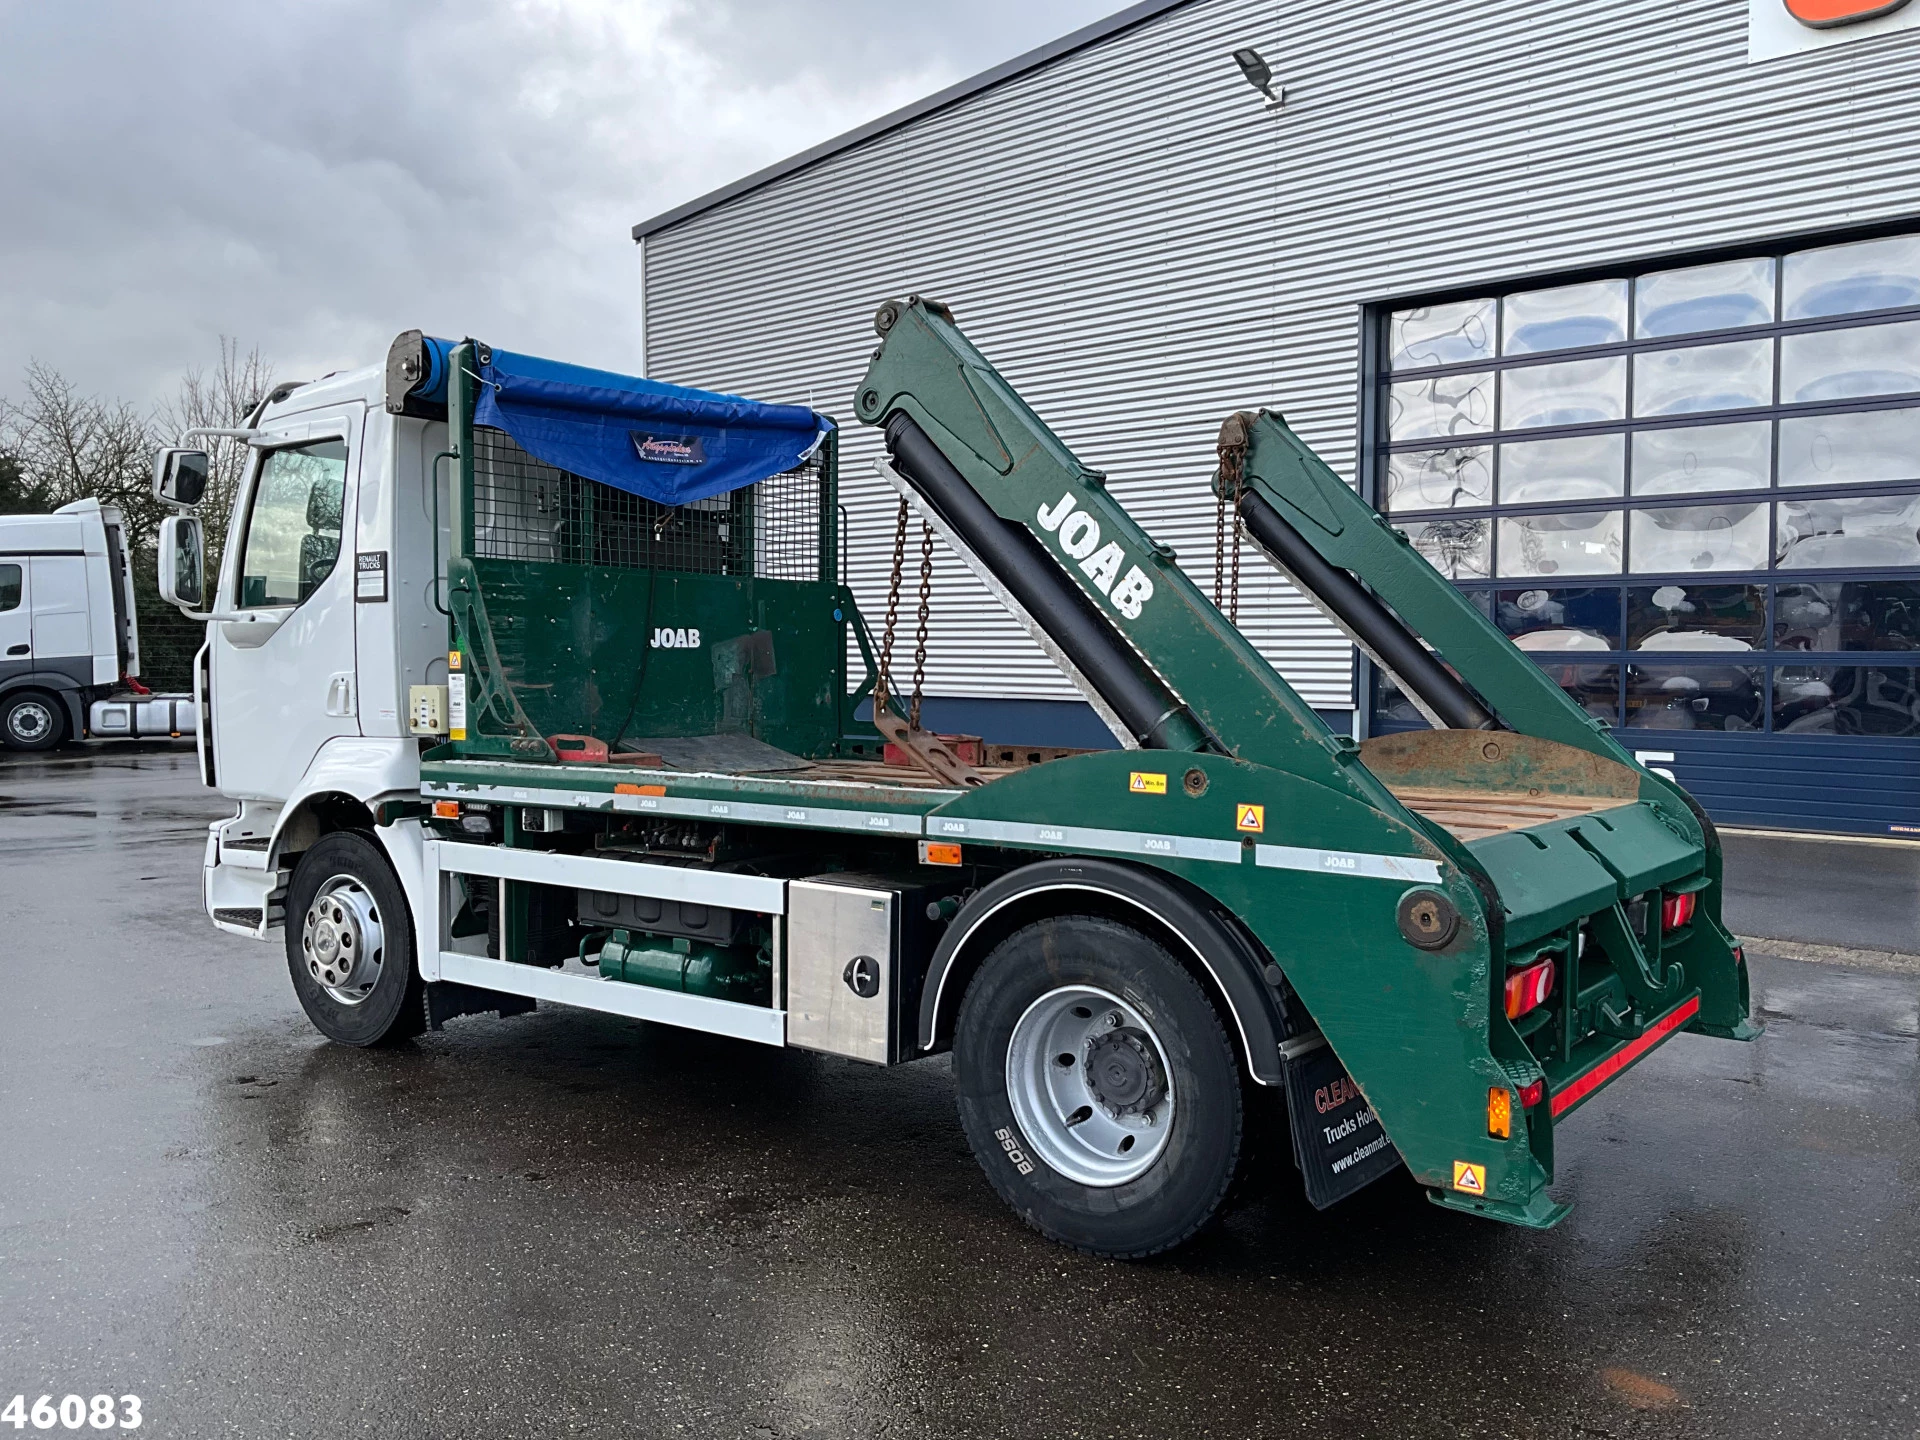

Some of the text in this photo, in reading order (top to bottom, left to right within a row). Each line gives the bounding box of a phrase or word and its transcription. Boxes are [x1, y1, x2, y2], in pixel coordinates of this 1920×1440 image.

[358, 554, 381, 563] RENAULT
[1036, 491, 1154, 620] JOAB
[358, 561, 381, 570] TRUCKS
[650, 627, 701, 648] JOAB
[640, 800, 657, 808] JOAB
[710, 805, 728, 814] JOAB
[787, 810, 806, 820] JOAB
[869, 817, 889, 827] JOAB
[943, 821, 965, 832] JOAB
[1039, 829, 1063, 840] JOAB
[1145, 839, 1171, 850] JOAB
[1324, 856, 1355, 869] JOAB
[1323, 1118, 1357, 1144] Trucks
[994, 1128, 1034, 1175] BOSS
